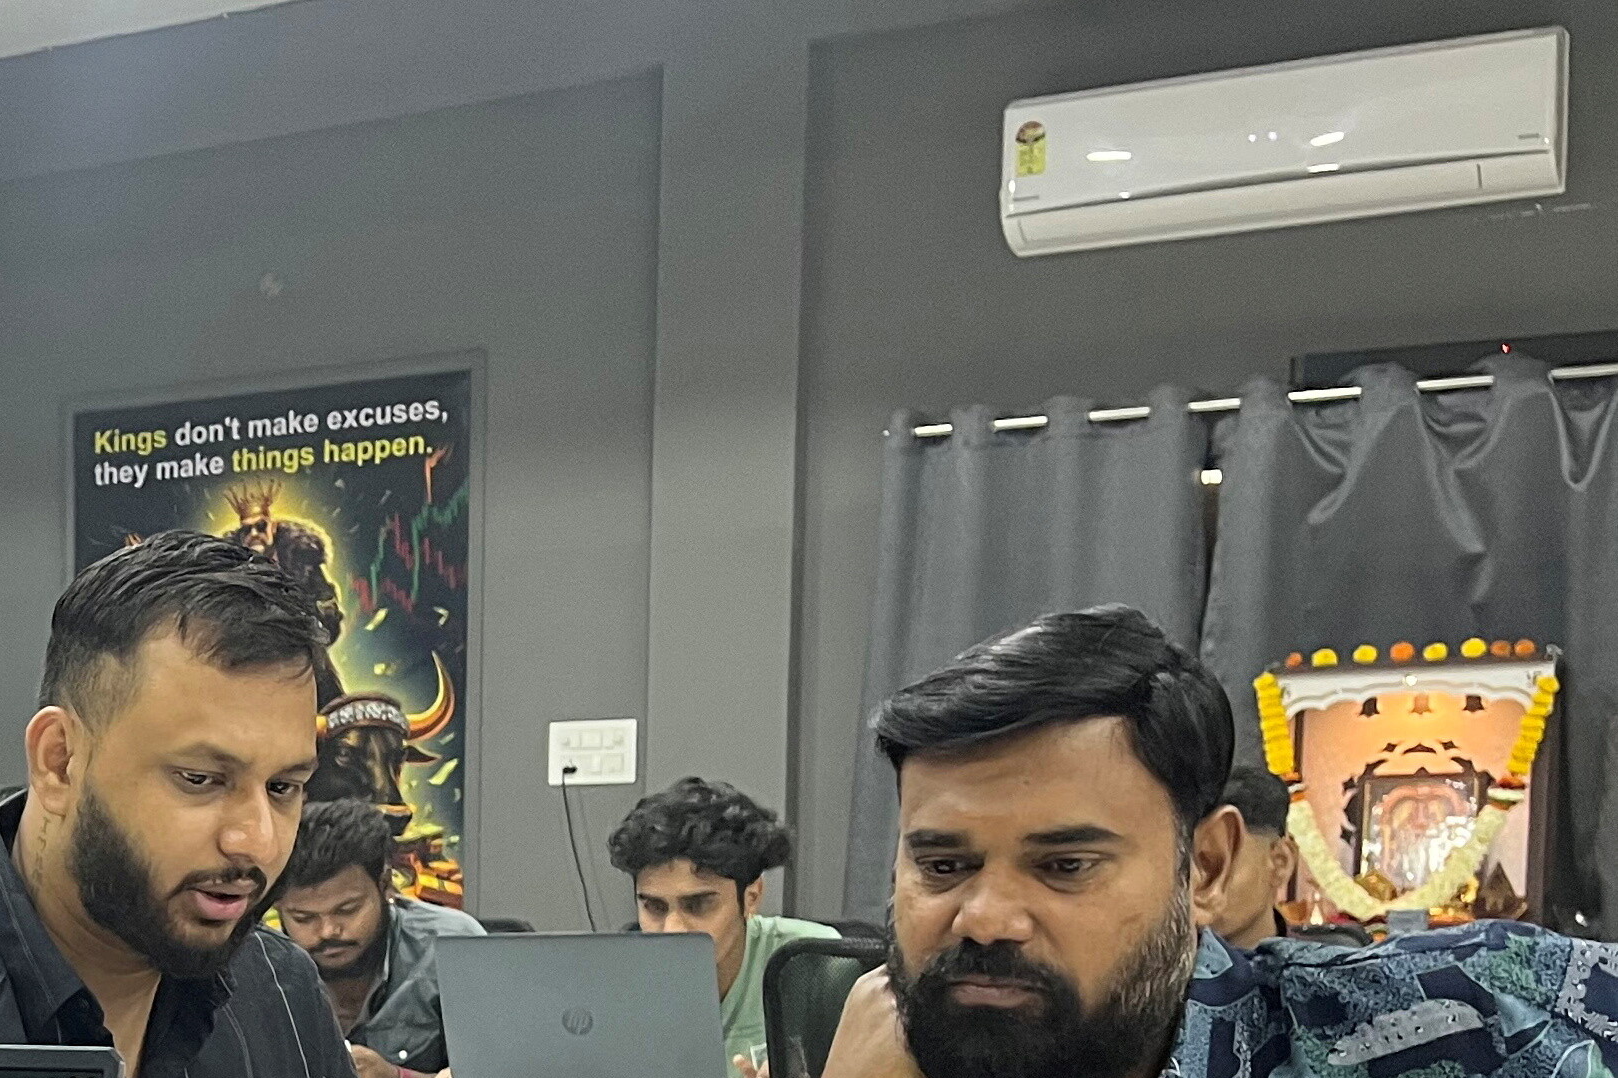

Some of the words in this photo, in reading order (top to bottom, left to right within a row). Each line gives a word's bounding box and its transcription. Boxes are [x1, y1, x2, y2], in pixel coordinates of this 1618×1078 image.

[94, 428, 167, 456] Kings
[175, 416, 240, 447] don't
[247, 410, 319, 441] make
[326, 400, 448, 430] excuses,
[94, 462, 148, 489] they
[155, 452, 225, 480] make
[232, 444, 315, 474] things
[323, 434, 433, 466] happen.
